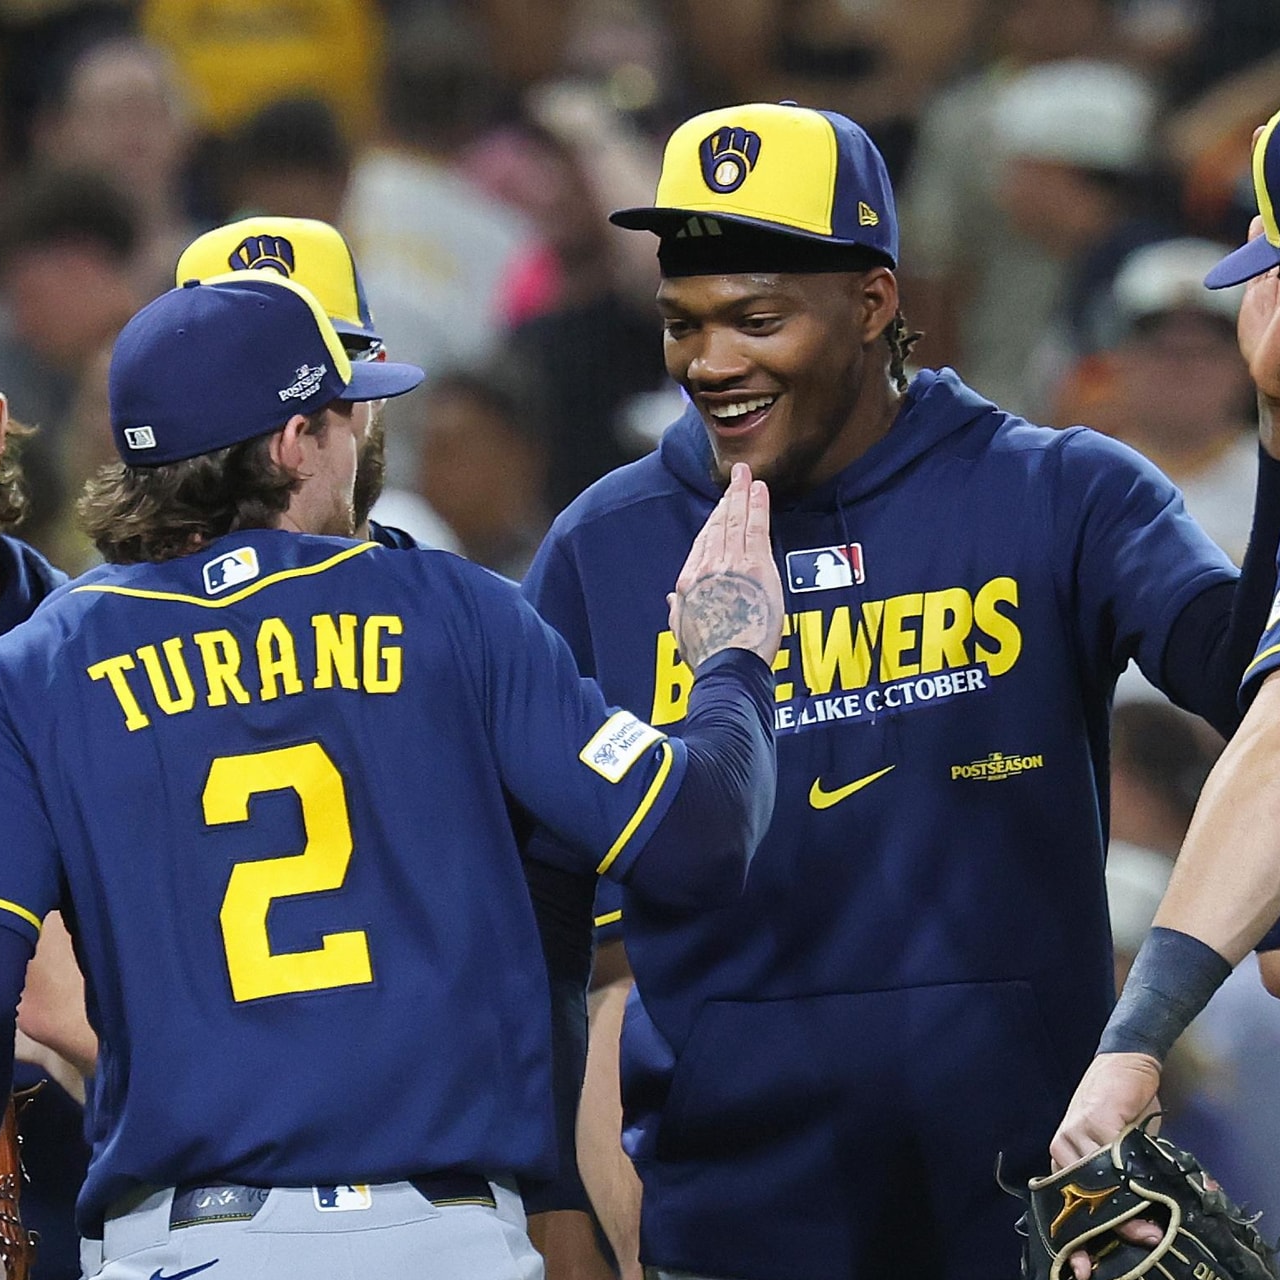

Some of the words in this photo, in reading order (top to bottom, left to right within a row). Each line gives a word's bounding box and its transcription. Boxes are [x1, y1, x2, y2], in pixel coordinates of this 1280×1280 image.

[87, 614, 404, 732] TURANG
[651, 577, 1022, 726] BEWERS
[801, 695, 862, 725] LIKE
[865, 668, 988, 713] OCTOBER
[951, 754, 1044, 780] POSTSEASON
[202, 741, 374, 1004] 2
